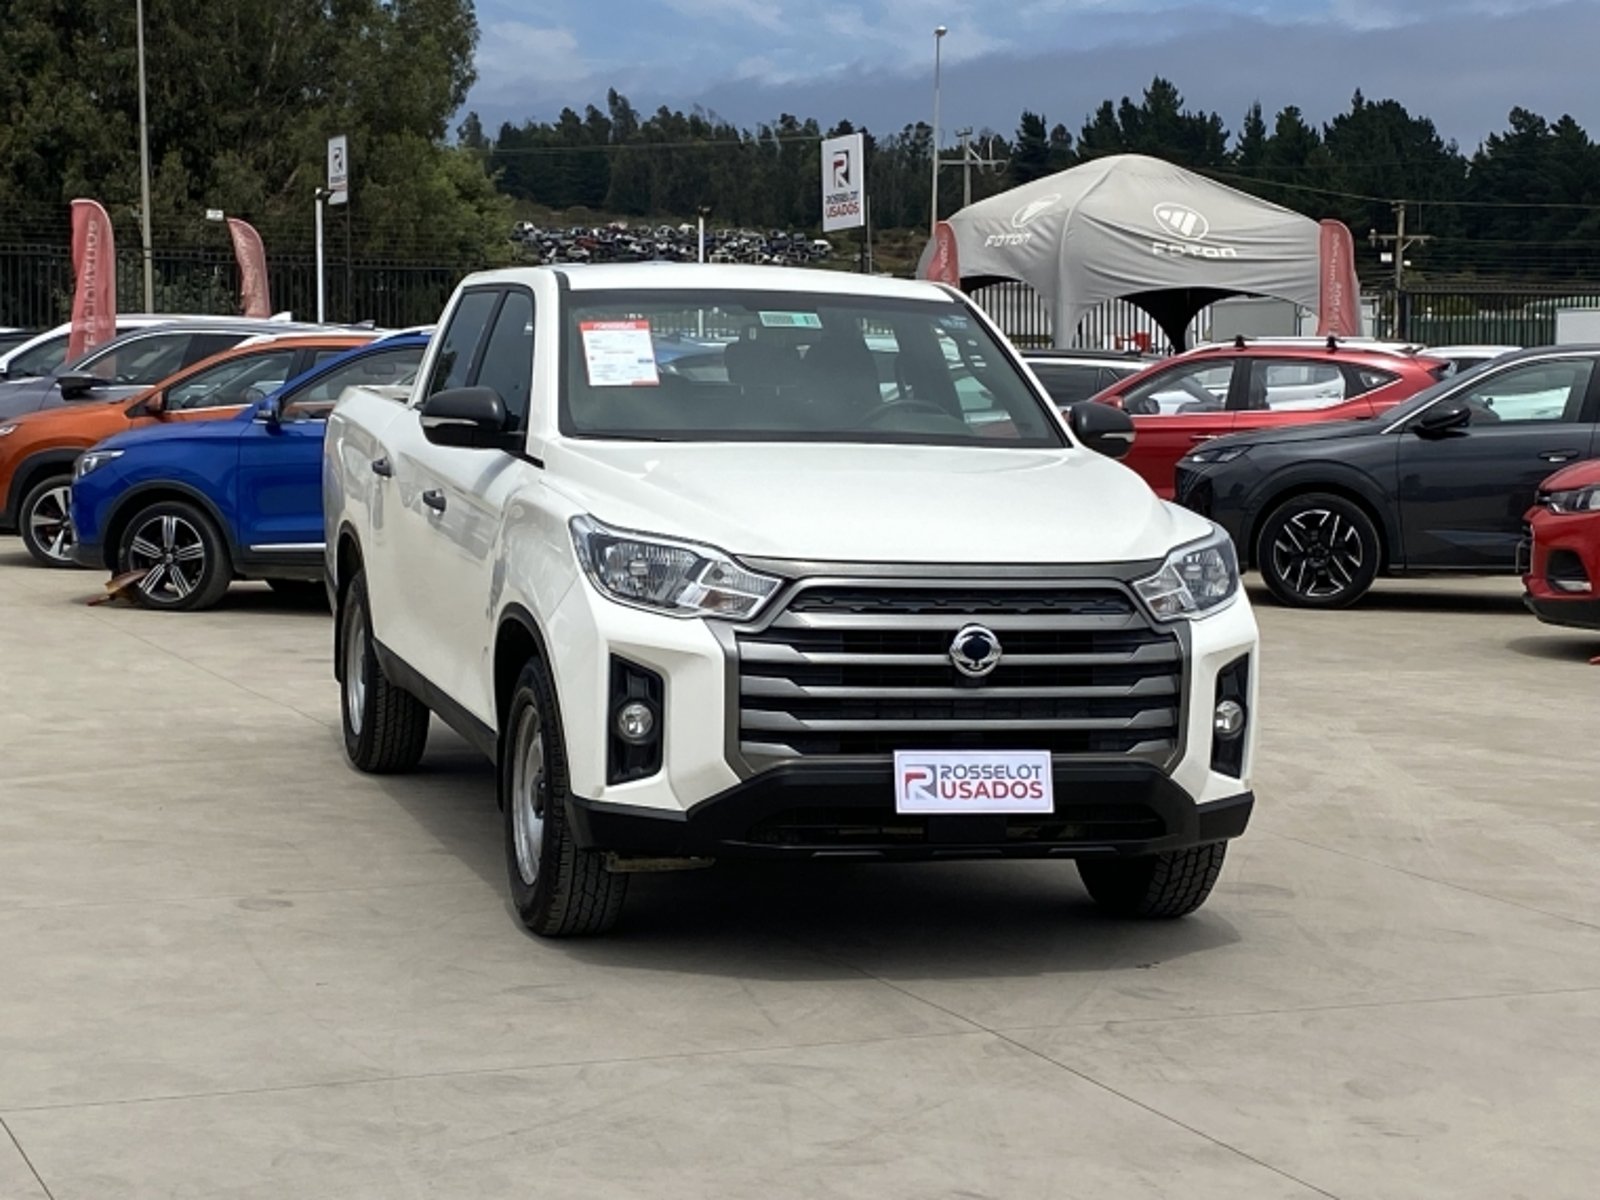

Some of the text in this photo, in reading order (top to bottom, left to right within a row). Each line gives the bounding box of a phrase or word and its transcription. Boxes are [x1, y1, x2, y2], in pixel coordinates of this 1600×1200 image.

[826, 202, 860, 218] USADOS
[940, 764, 1042, 780] ROSSELOT
[941, 781, 1044, 800] USADOS
